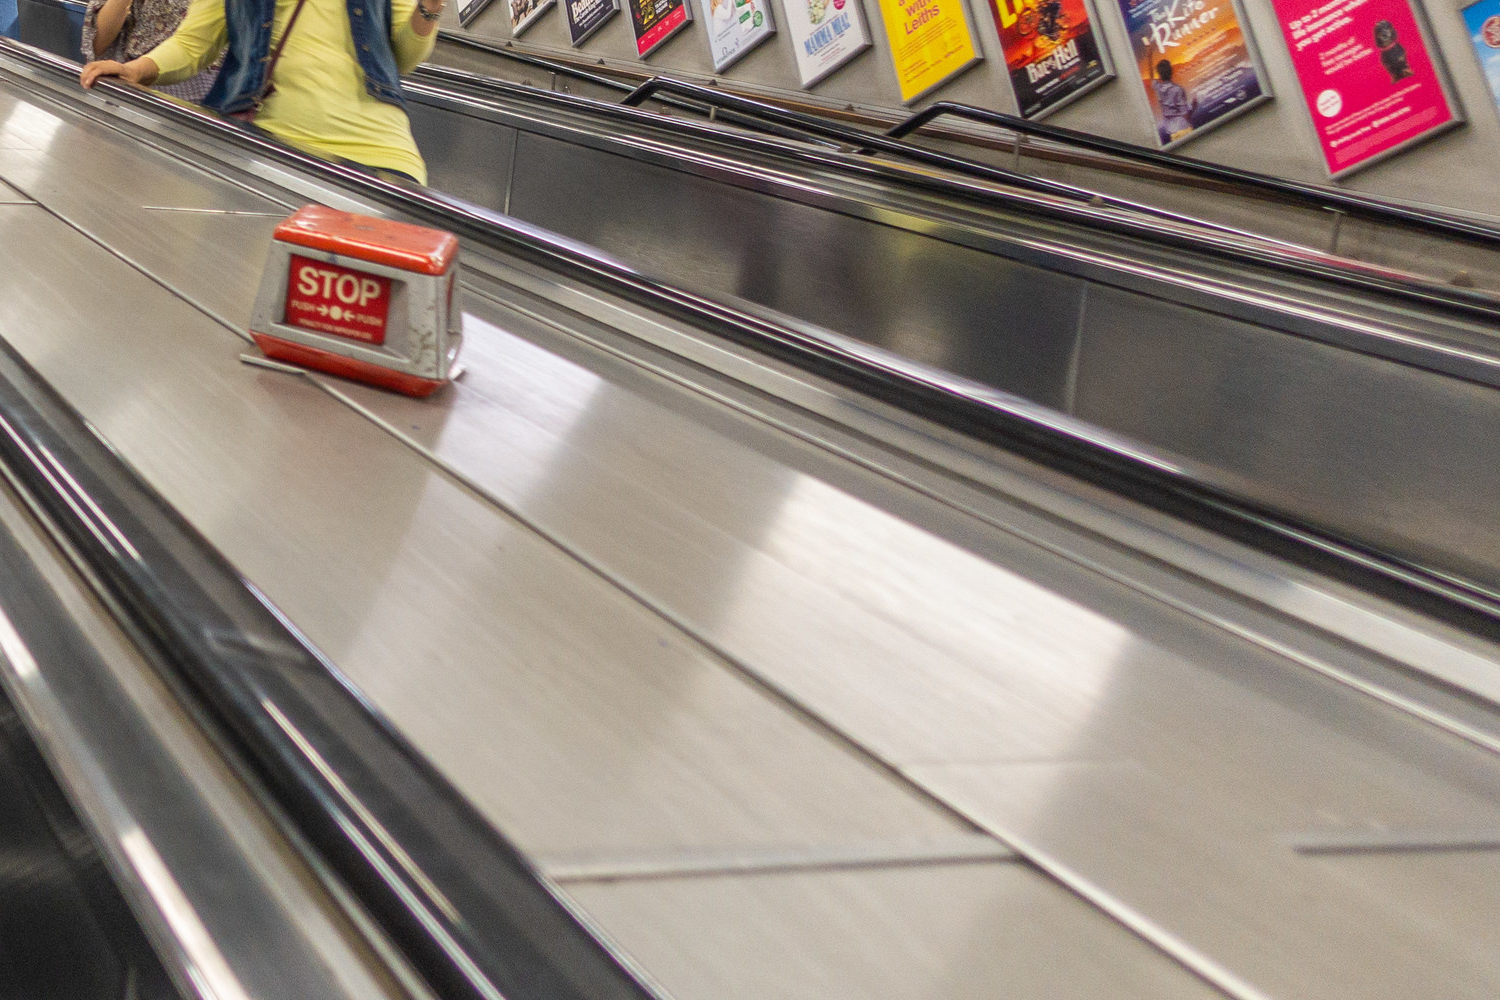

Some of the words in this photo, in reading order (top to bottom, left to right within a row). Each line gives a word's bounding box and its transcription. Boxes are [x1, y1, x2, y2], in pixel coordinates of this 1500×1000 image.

[641, 4, 655, 25] 25
[904, 4, 940, 36] Leiths
[1147, 8, 1169, 23] The
[1289, 20, 1302, 30] Up
[1311, 9, 1318, 18] 2
[1292, 28, 1306, 40] life
[1306, 8, 1344, 32] insurance
[804, 24, 833, 56] MAMMA
[831, 12, 851, 35] MIA!
[1149, 7, 1219, 54] Runner
[1296, 37, 1312, 51] you
[1312, 30, 1327, 43] get
[1054, 39, 1080, 70] Hell
[297, 266, 381, 307] STOP
